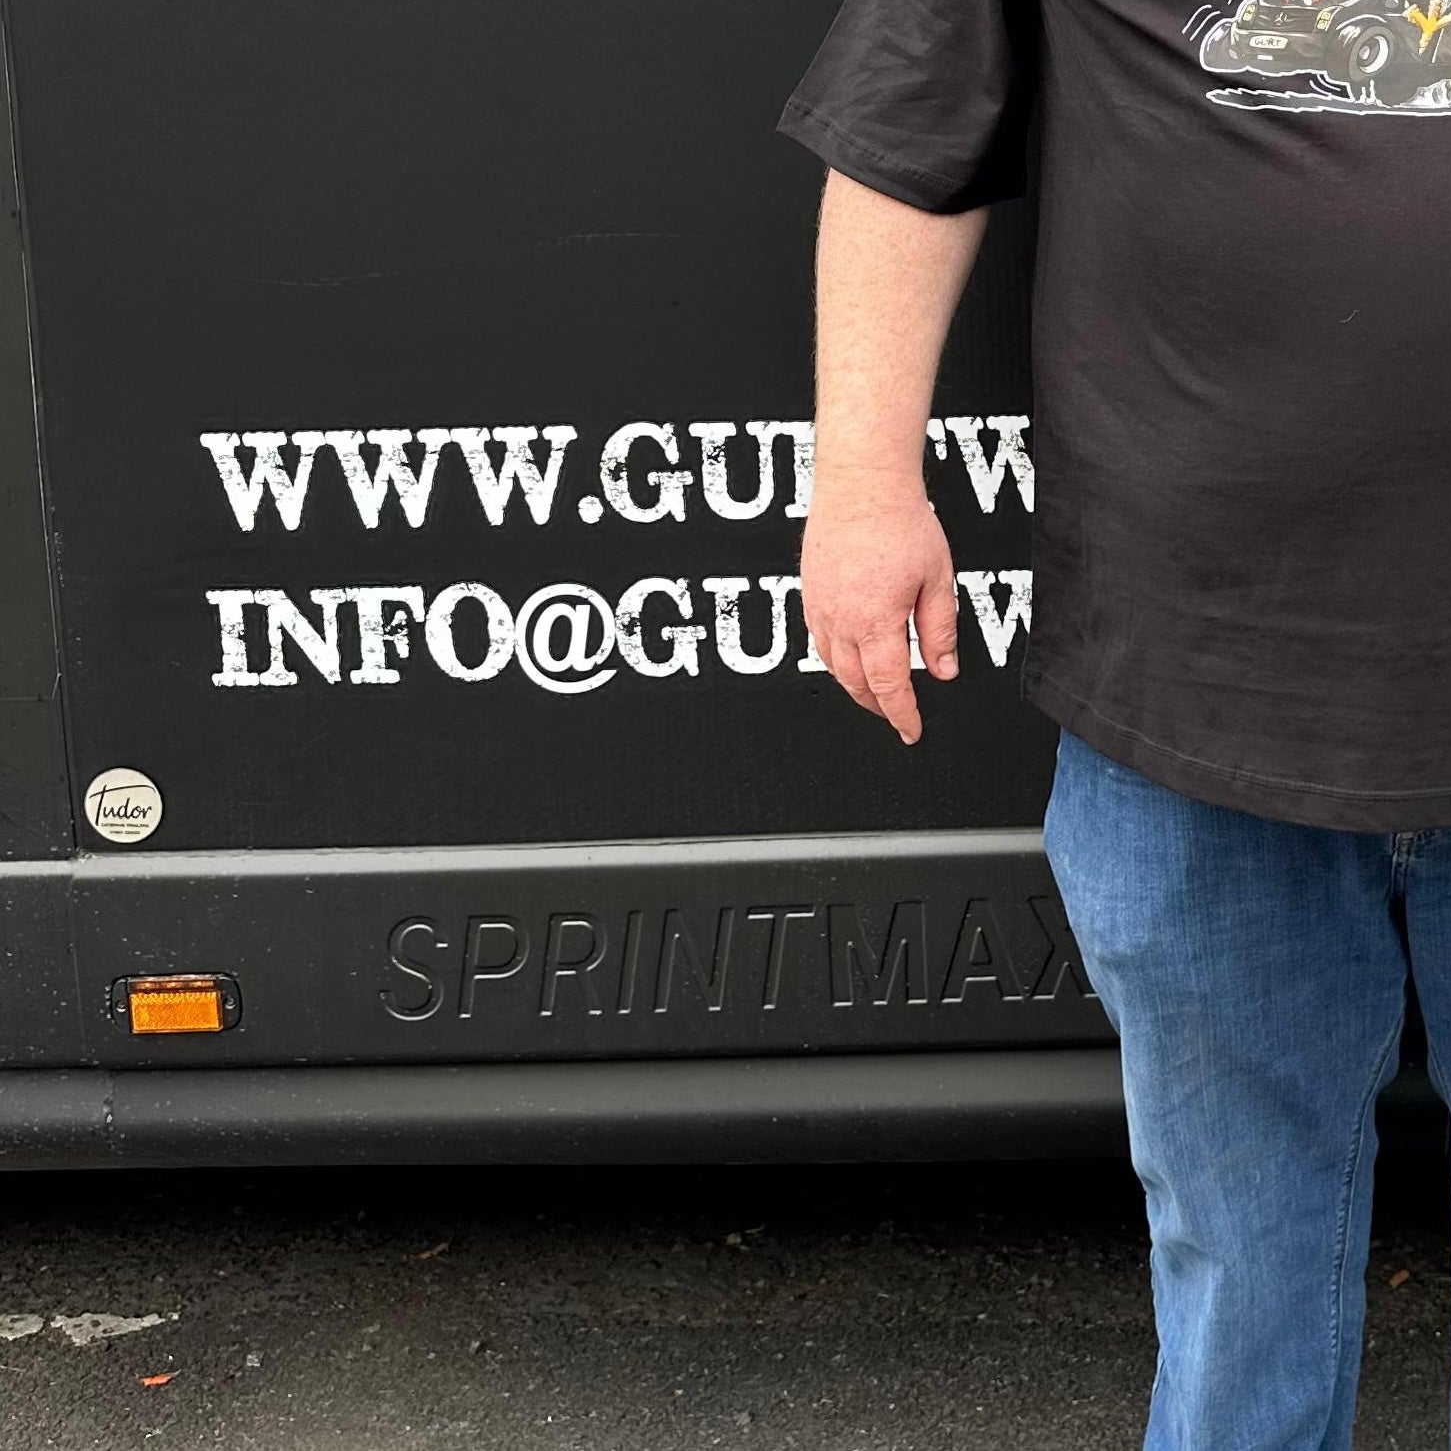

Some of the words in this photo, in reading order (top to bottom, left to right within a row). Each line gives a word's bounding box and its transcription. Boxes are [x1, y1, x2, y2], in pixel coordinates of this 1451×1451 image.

[200, 415, 1035, 532] WWW.GUW
[205, 569, 1034, 695] INFO@GUW
[89, 784, 156, 826] Tudor
[377, 896, 1100, 1022] SPRINTMAX
